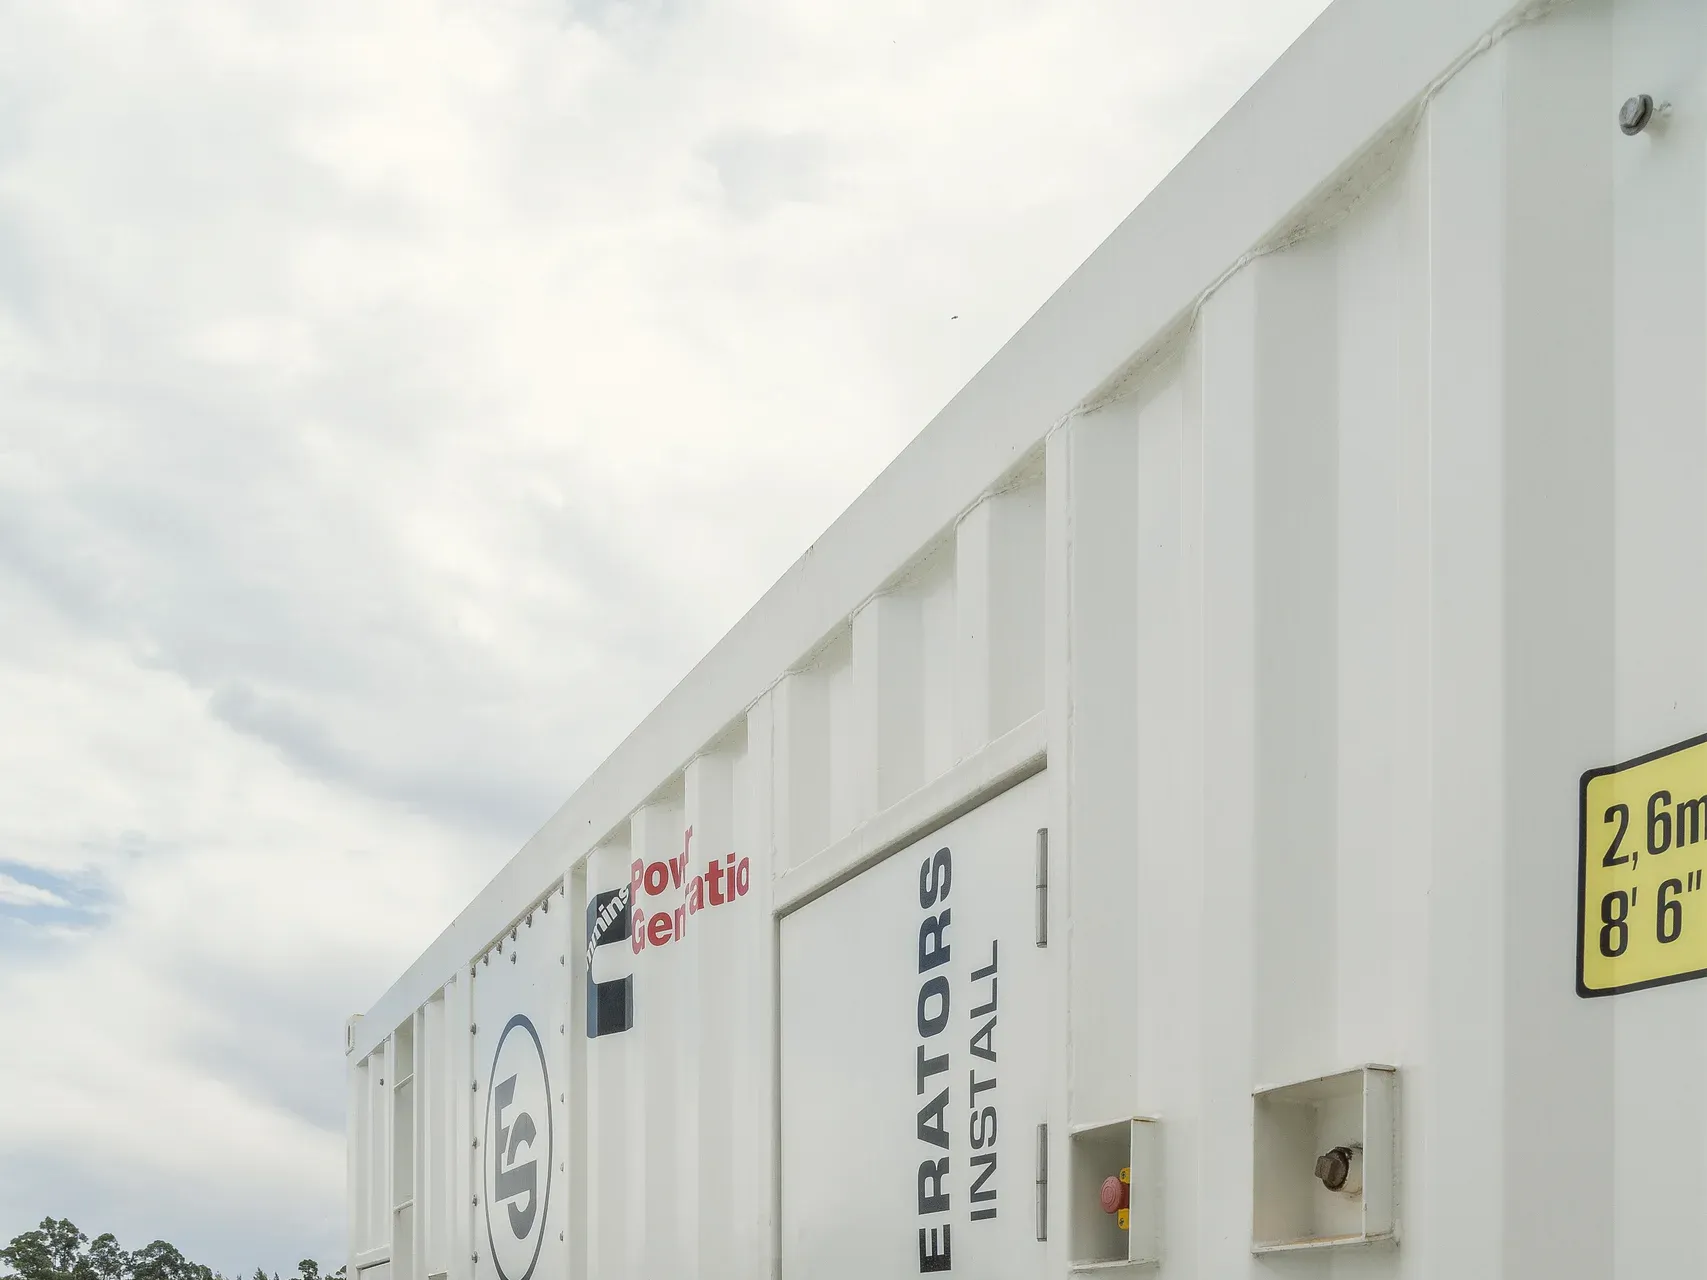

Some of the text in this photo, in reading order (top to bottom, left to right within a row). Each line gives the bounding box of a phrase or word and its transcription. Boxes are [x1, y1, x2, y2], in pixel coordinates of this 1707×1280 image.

[631, 825, 693, 906] Powr
[1602, 790, 1707, 872] 2,6m
[969, 939, 998, 1222] INSTALL
